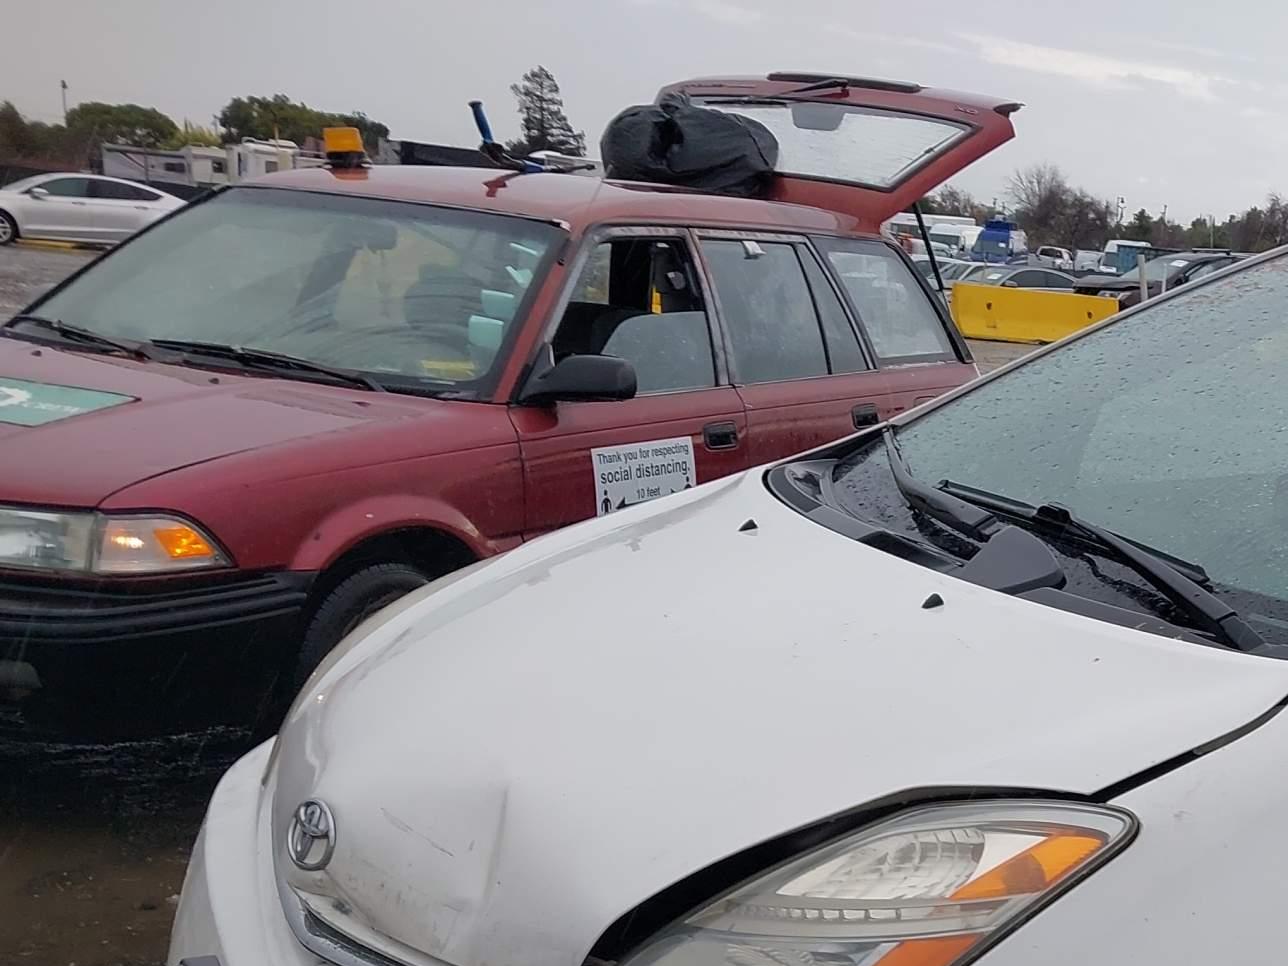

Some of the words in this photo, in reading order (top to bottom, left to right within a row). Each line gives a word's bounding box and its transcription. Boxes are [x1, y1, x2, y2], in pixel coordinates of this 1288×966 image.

[597, 452, 622, 465] Thank
[624, 450, 638, 464] you
[639, 447, 651, 459] for
[652, 443, 689, 458] respecting
[600, 467, 633, 484] social
[636, 459, 691, 479] distancing.
[636, 489, 645, 499] 10
[646, 487, 661, 498] feet
